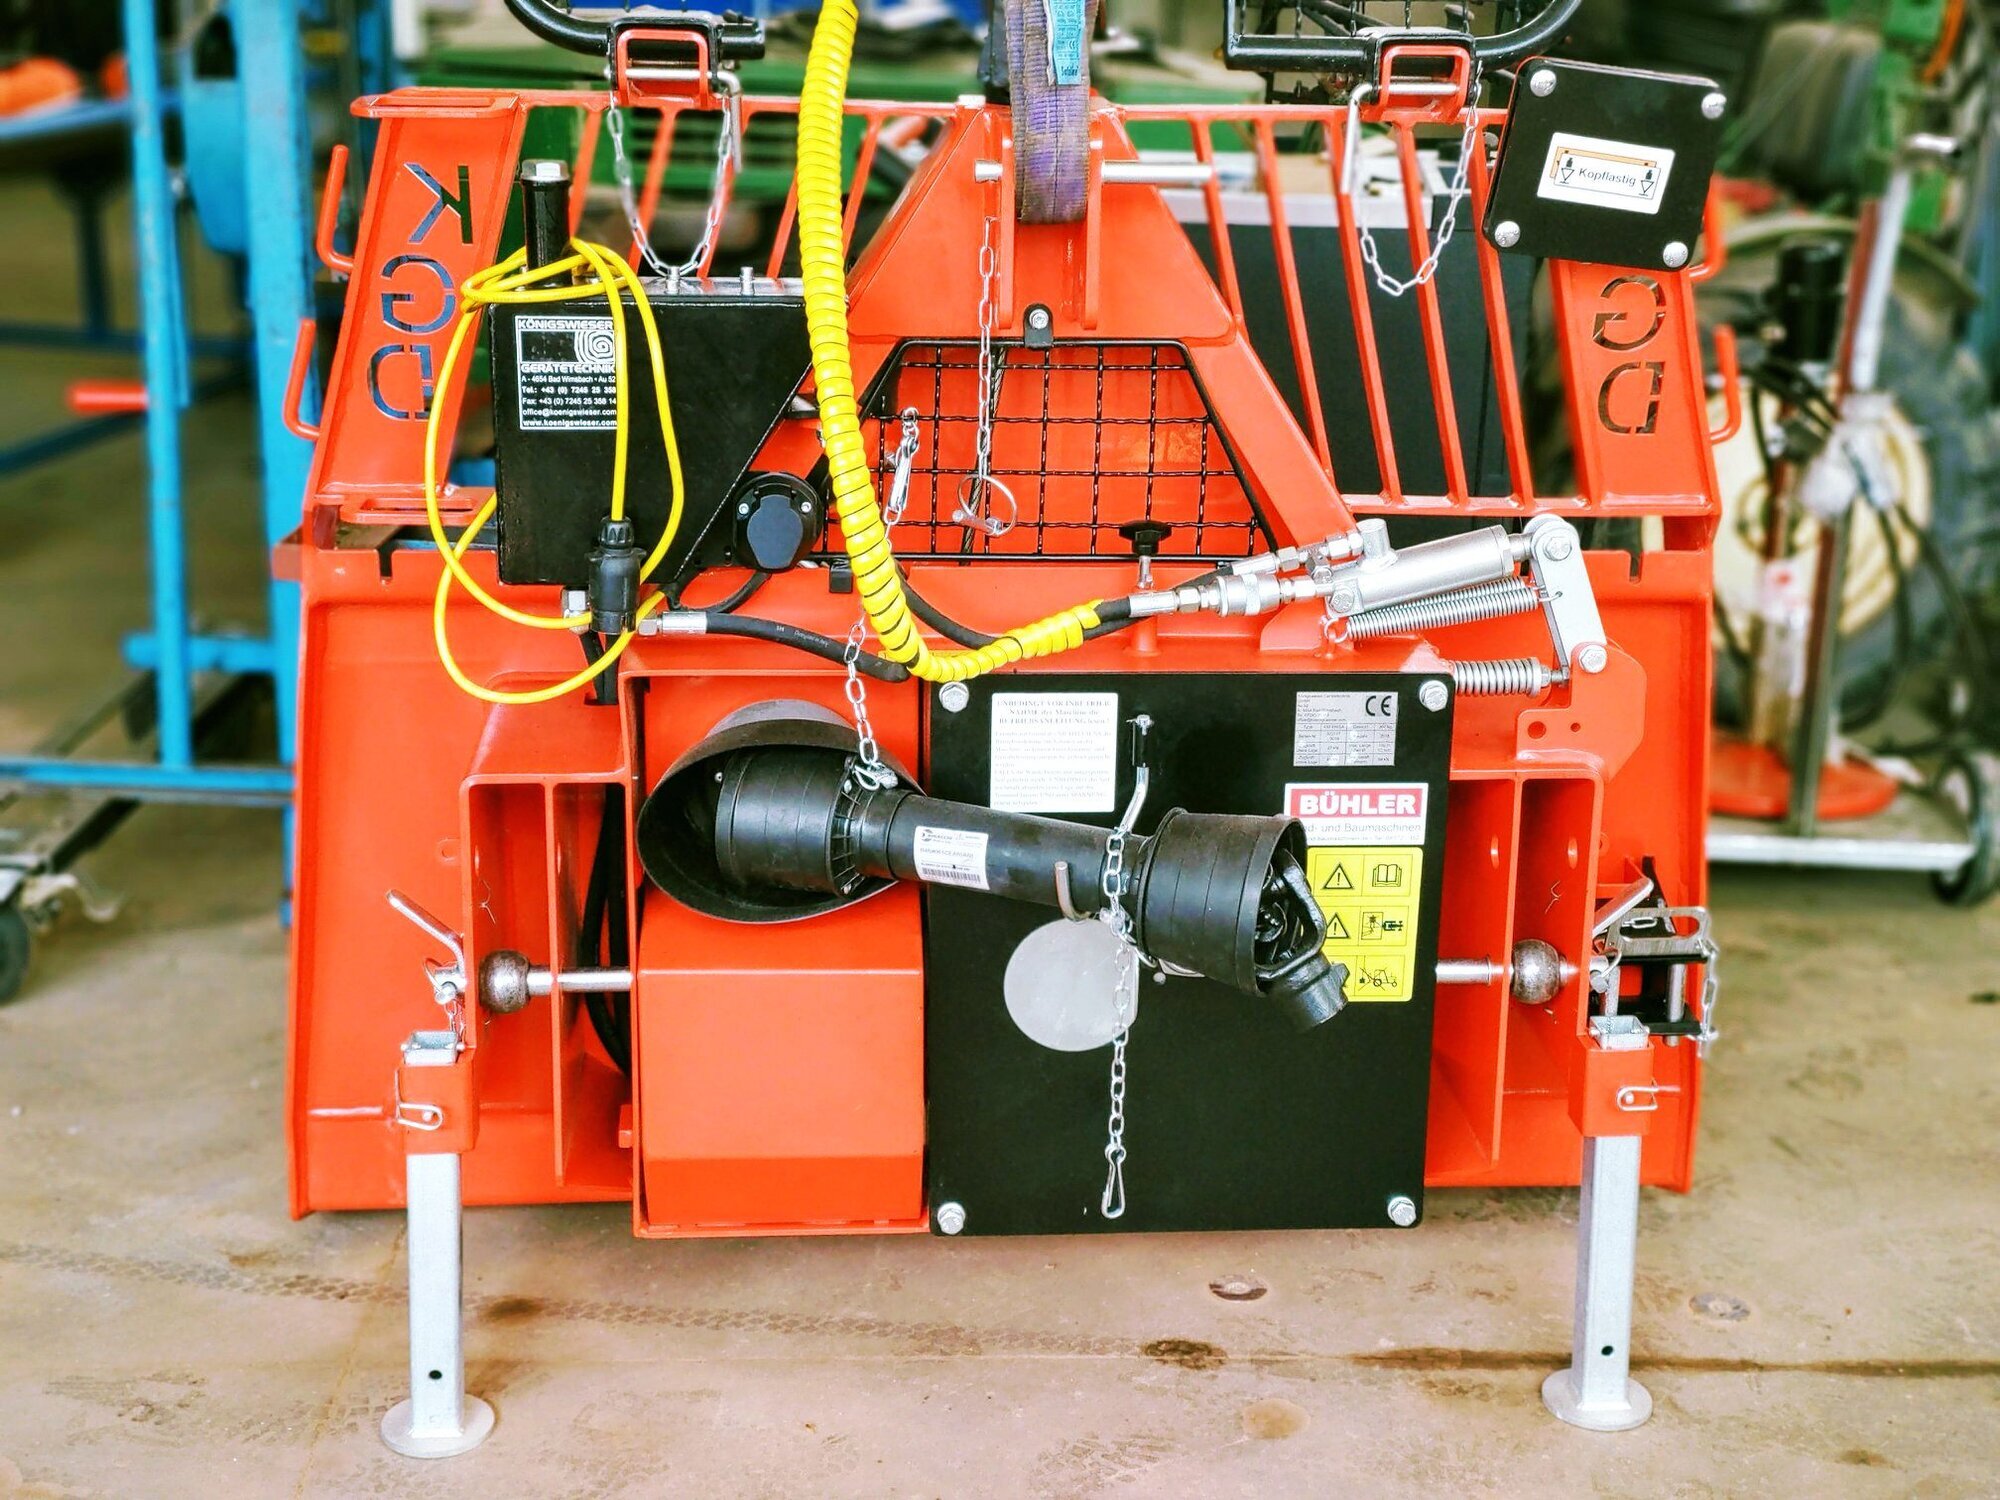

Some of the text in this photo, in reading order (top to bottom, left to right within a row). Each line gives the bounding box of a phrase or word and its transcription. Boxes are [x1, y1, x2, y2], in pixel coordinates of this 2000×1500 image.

[1578, 168, 1637, 187] Kopflastig
[519, 318, 613, 329] KÖNIGSWIESER
[521, 362, 615, 373] GERÄTETECHNIK
[522, 408, 617, 417] office@koenigswieser.com
[523, 420, 617, 428] www.koenigswieser.com
[1300, 790, 1416, 815] BÜHLER
[1321, 824, 1340, 832] und
[1344, 823, 1421, 832] Baumaschinen
